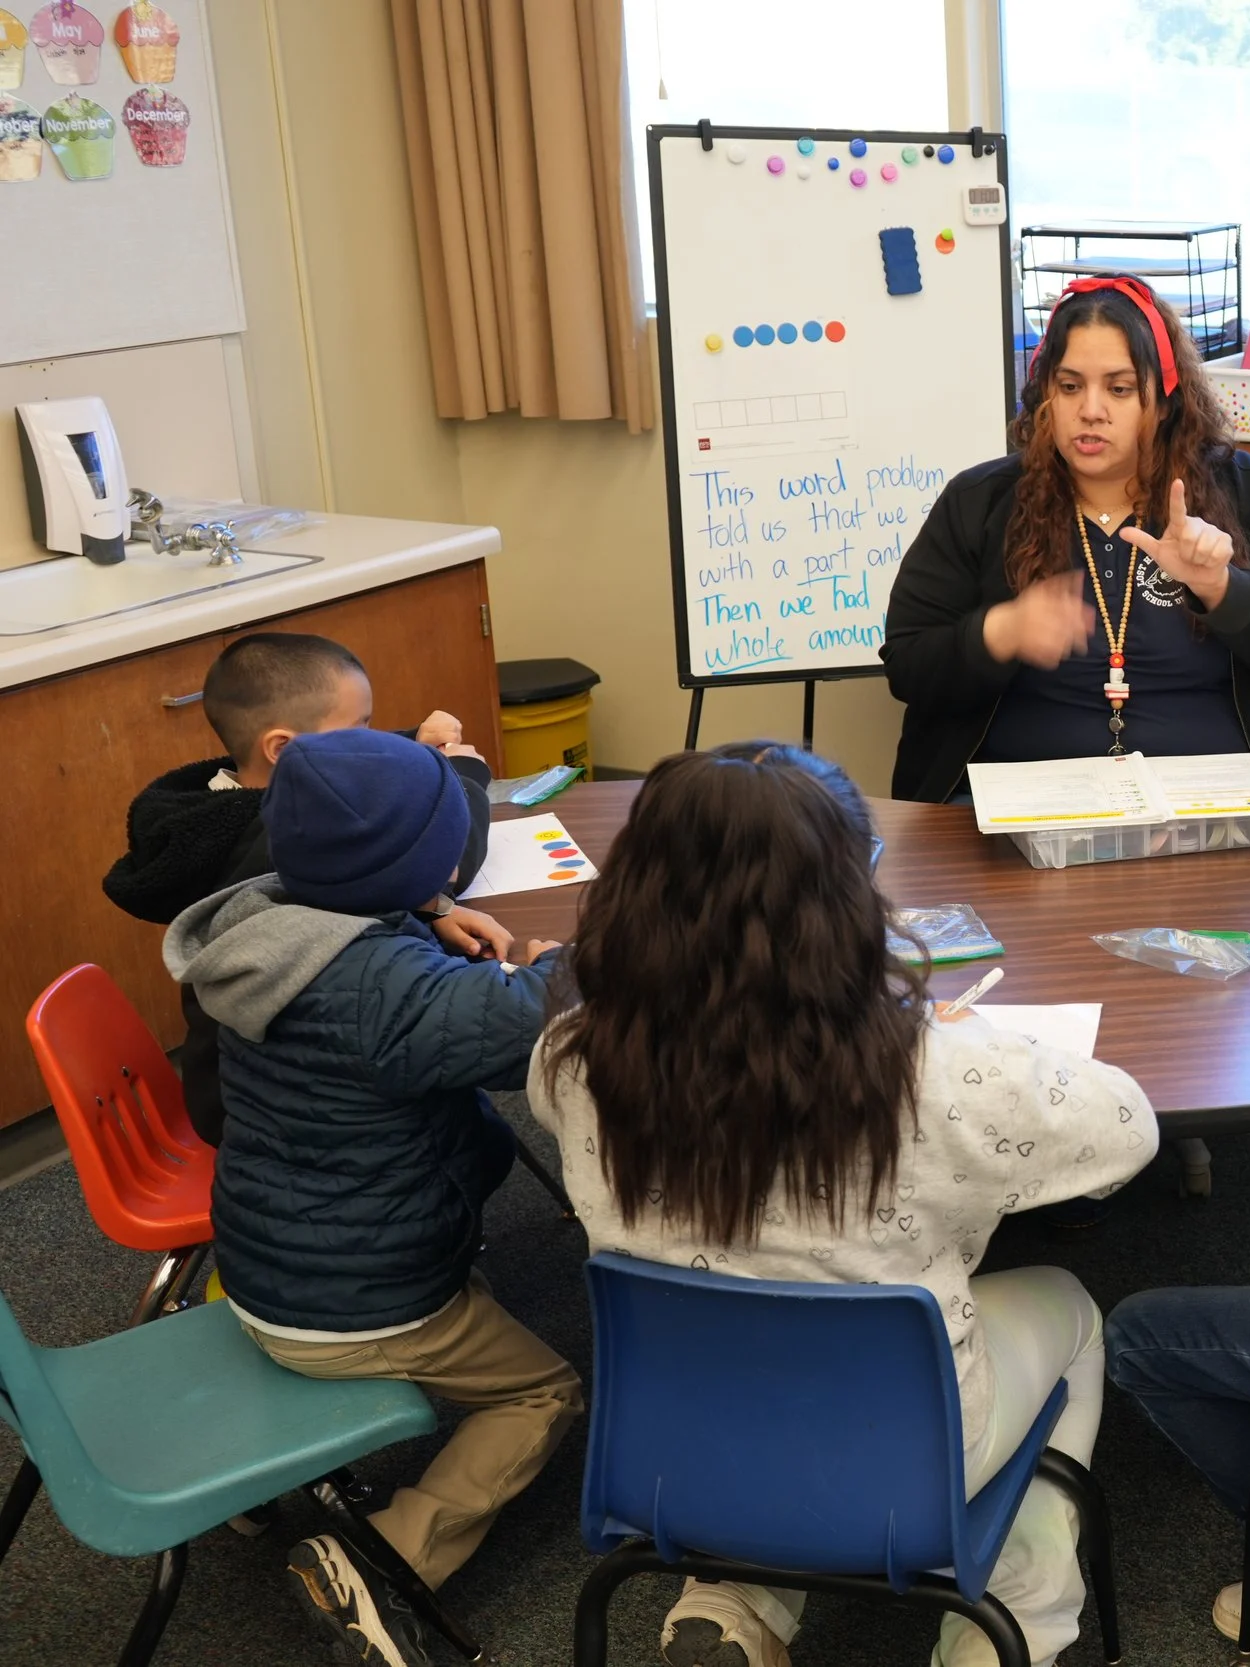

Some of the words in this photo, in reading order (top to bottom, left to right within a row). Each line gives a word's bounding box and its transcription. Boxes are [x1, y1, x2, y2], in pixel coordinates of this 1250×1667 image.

[52, 22, 82, 40] May
[131, 25, 160, 39] June
[46, 117, 112, 132] November
[127, 107, 187, 121] December
[689, 471, 754, 510] This
[779, 458, 847, 501] word
[867, 455, 945, 508] problem
[698, 509, 750, 550] told
[761, 520, 787, 542] us
[808, 498, 867, 533] that
[877, 505, 908, 527] we
[699, 551, 753, 587] with
[772, 558, 790, 579] a
[804, 538, 855, 588] part
[867, 532, 902, 567] and
[1136, 563, 1147, 588] LOST
[695, 593, 761, 626] Then
[779, 595, 815, 618] we
[832, 570, 870, 611] had
[1142, 590, 1173, 607] SCHOOL
